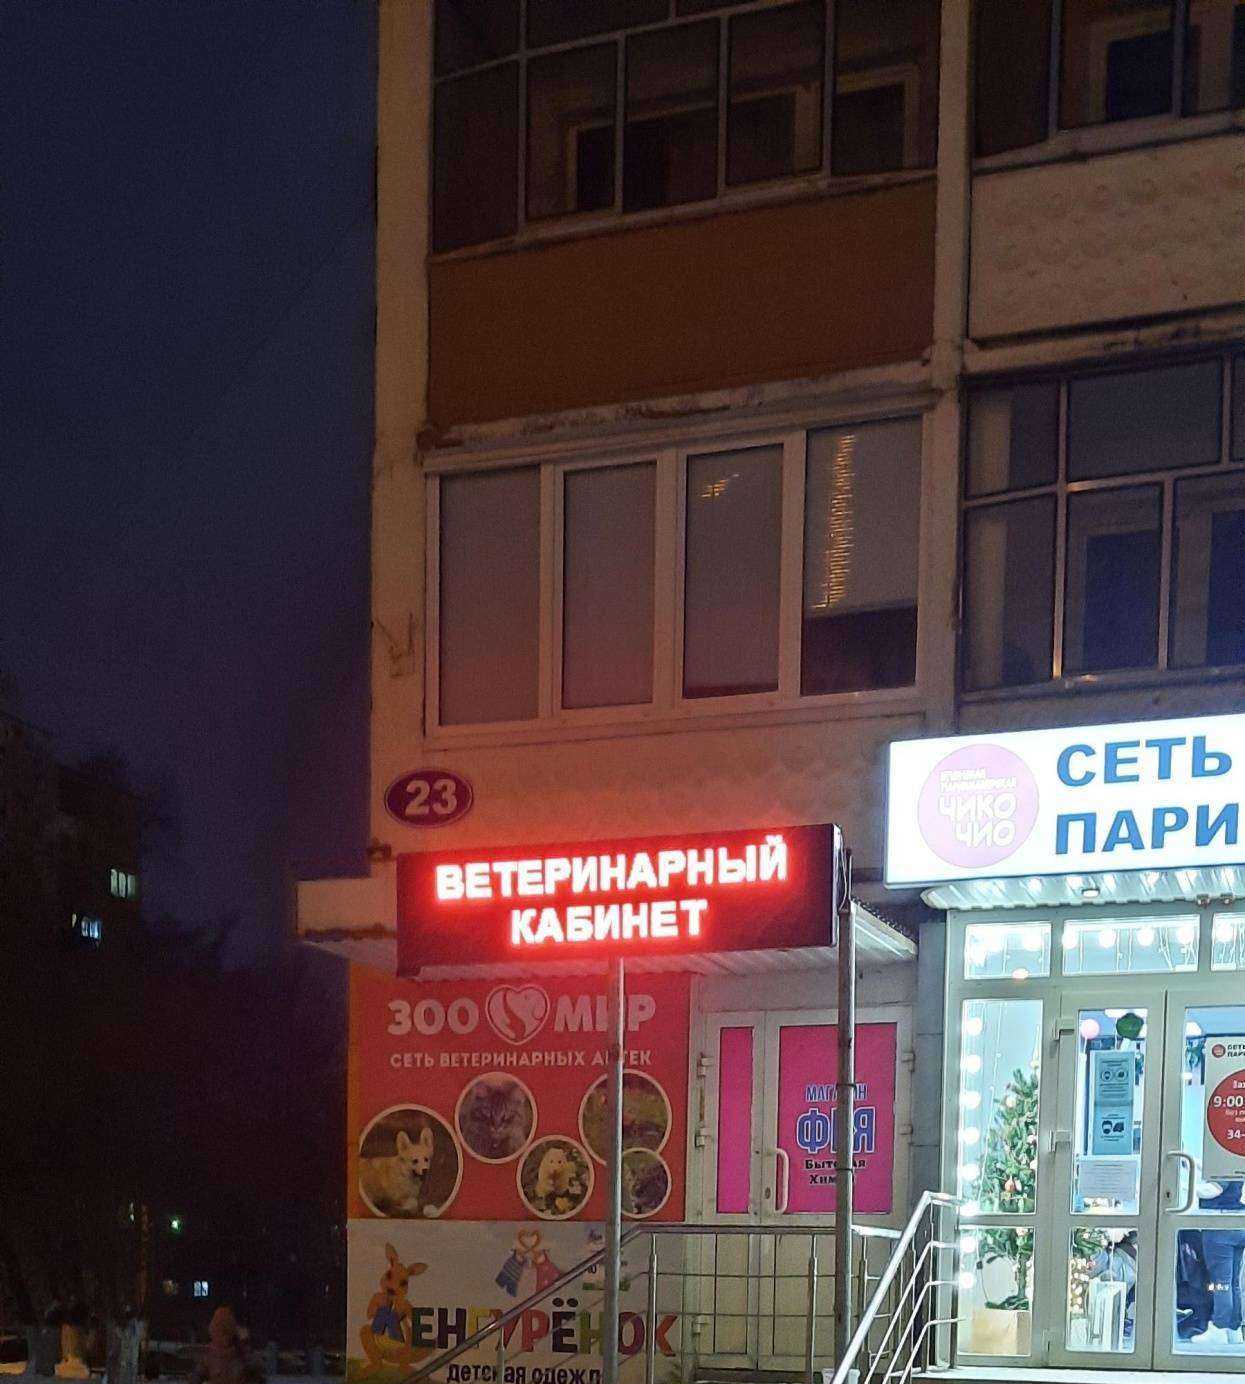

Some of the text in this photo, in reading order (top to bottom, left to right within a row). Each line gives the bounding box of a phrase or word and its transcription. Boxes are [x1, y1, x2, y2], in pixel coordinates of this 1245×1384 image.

[1056, 735, 1233, 787] СЕТЬ
[405, 778, 458, 816] 23
[1055, 802, 1240, 854] ПАРИ
[435, 835, 788, 901] ВЕТЕРИНАРНЫЙ
[510, 898, 709, 945] КАБИНЕТ
[387, 998, 480, 1035] ЗОО
[390, 1053, 435, 1068] СЕТЬ
[440, 1051, 585, 1068] ВЕТЕРИНАРНЫХ
[806, 1083, 868, 1102] МАГН
[805, 1159, 866, 1170] Бытая
[372, 1297, 678, 1357] ЕНГУРЁНОК
